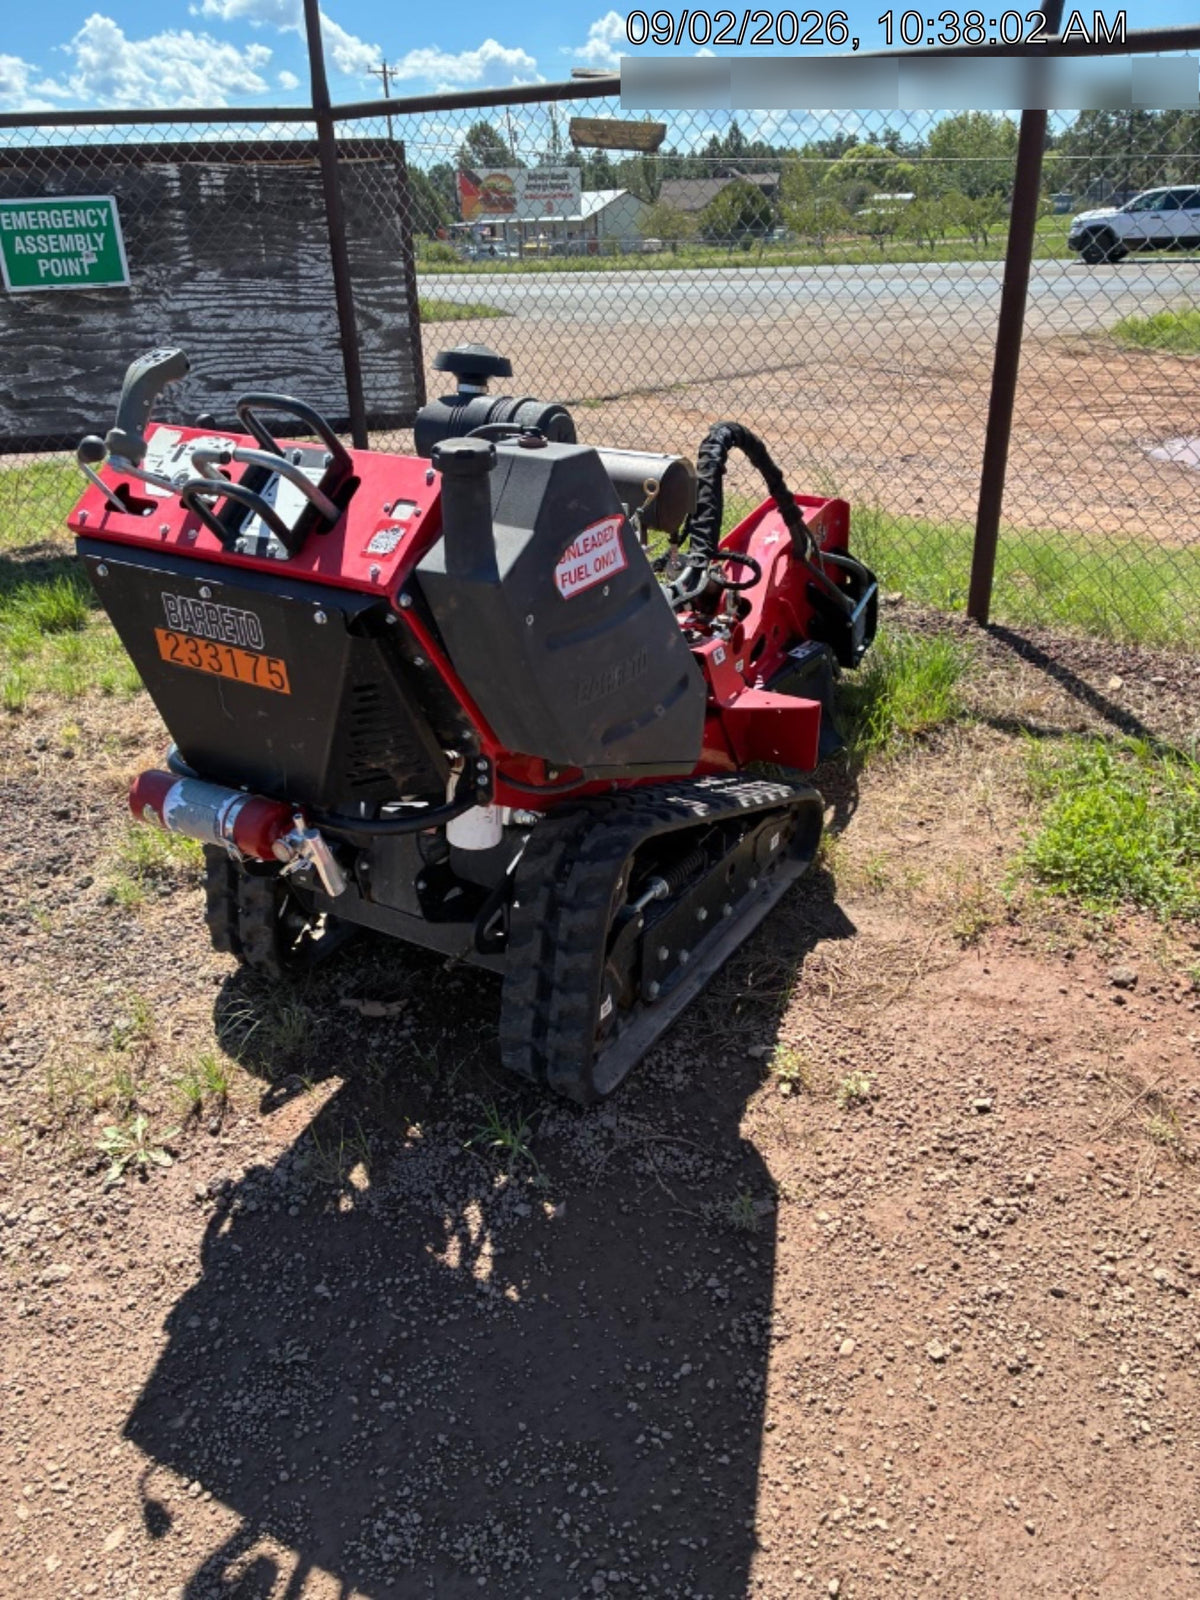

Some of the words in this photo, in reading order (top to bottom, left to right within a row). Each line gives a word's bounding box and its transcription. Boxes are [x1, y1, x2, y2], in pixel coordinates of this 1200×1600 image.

[0, 208, 108, 230] EMERGENCY
[14, 232, 105, 254] ASSEMBLY
[38, 256, 94, 278] POINT
[560, 563, 592, 589] FUEL
[593, 547, 618, 573] ONLY
[161, 592, 265, 650] BARRETO
[165, 632, 286, 690] 233175
